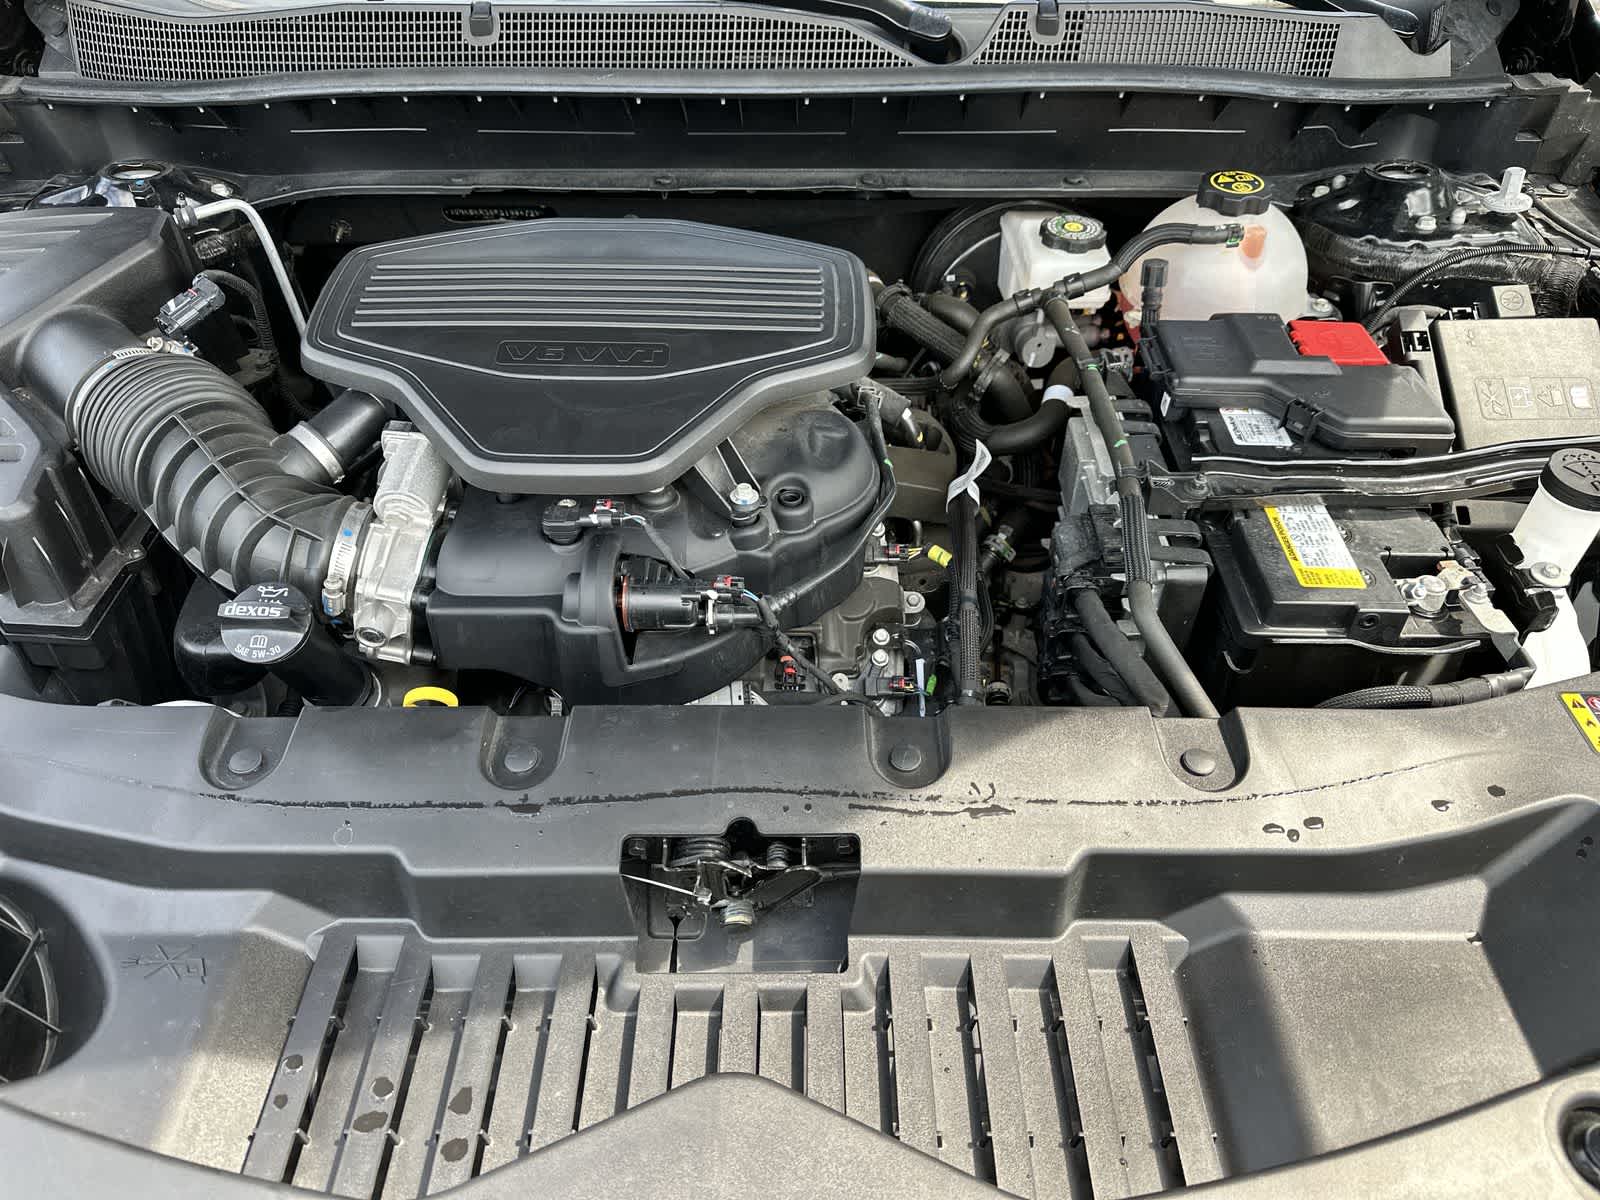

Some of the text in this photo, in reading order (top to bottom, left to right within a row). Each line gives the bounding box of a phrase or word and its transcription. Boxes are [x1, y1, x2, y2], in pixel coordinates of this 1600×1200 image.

[505, 343, 664, 362] V6 VVT
[224, 603, 284, 616] dexos
[234, 643, 281, 658] SAE 5W-30
